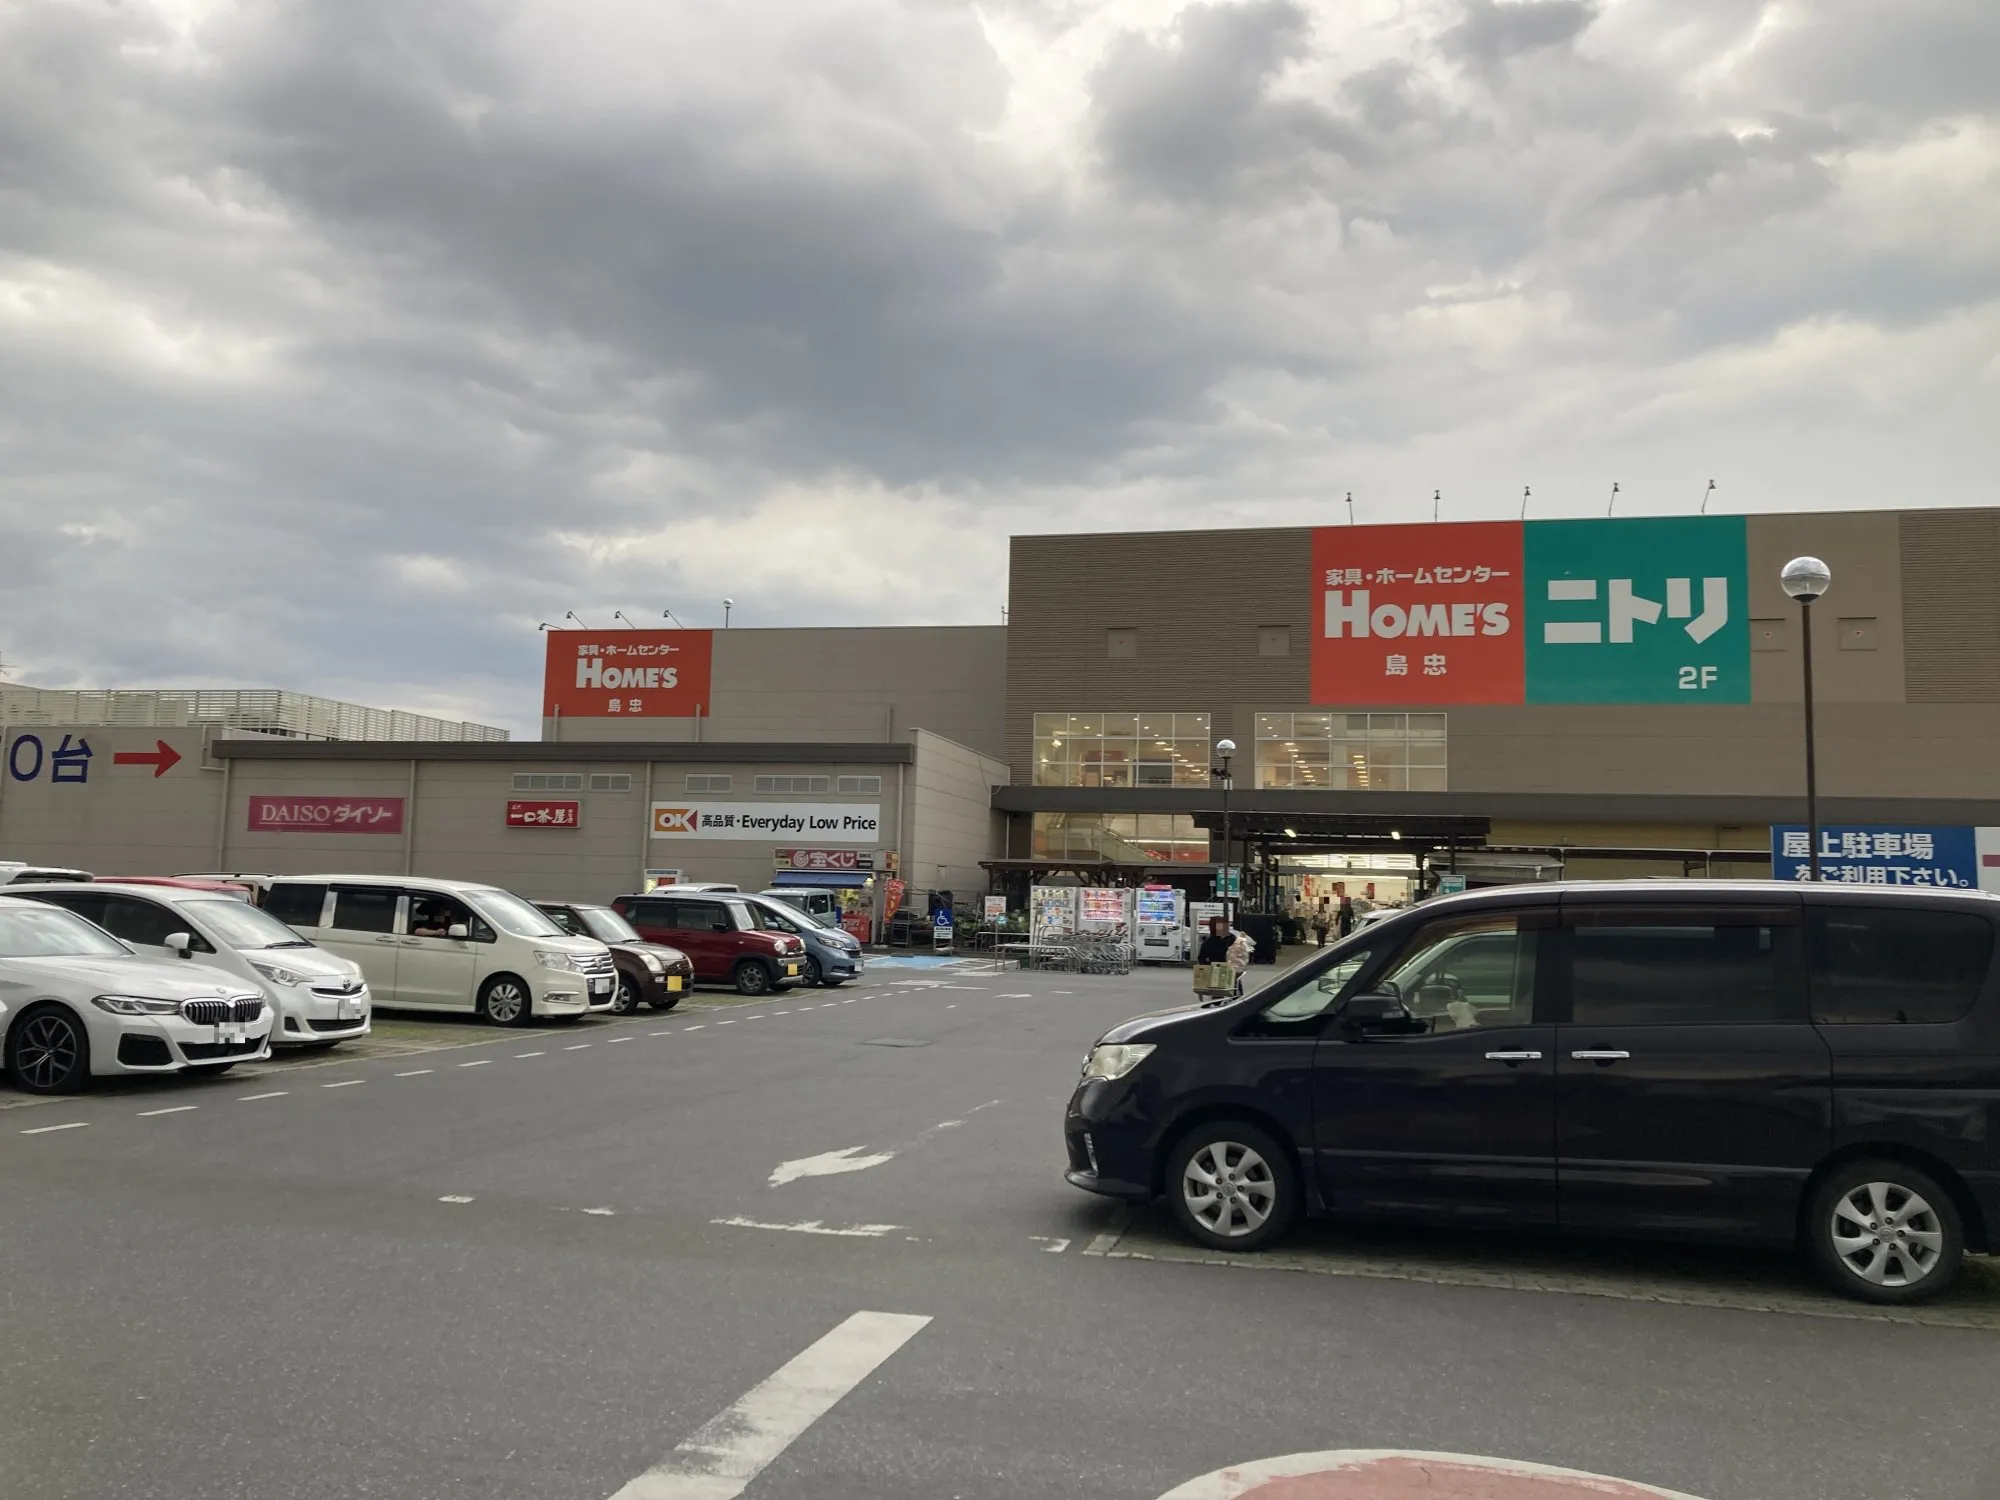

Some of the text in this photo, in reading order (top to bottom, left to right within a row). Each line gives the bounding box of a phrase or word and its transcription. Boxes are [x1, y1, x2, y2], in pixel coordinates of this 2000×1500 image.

[1325, 566, 1510, 586] 家具・ホームセンター
[1324, 590, 1510, 639] HOME'S
[1544, 577, 1728, 645] ニトリ
[578, 644, 680, 656] 家具・ホームセンター
[576, 658, 678, 689] HOME'S
[1385, 653, 1447, 676] 島忠
[1678, 666, 1717, 690] 2F
[261, 804, 393, 824] DAISO ダイソー
[659, 809, 698, 832] OK
[809, 816, 839, 829] Low
[843, 816, 877, 830] Price
[1782, 831, 1935, 860] 屋上駐車場
[810, 852, 855, 868] 宝くじ
